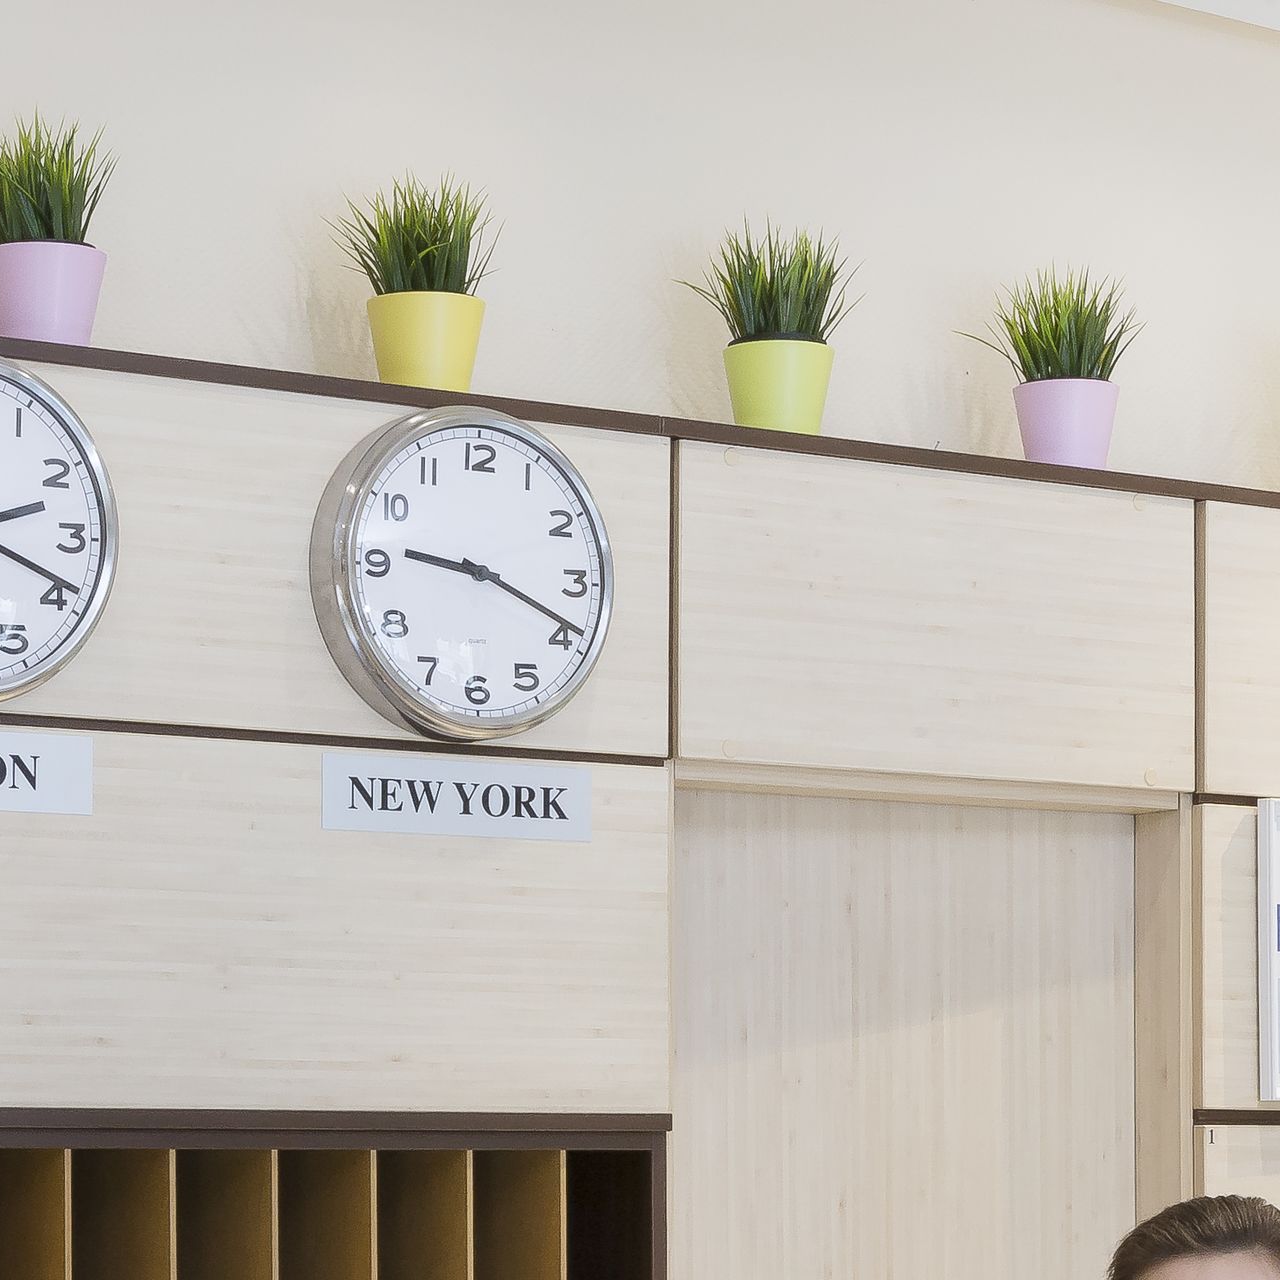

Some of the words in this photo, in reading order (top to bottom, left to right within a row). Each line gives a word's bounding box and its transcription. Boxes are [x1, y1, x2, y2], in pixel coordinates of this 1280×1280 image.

[15, 407, 22, 438] 1
[420, 457, 438, 487] 11
[464, 442, 496, 474] 12
[41, 458, 71, 489] 2
[525, 463, 531, 491] 1
[383, 493, 409, 522] 10
[56, 522, 86, 554] 3
[548, 510, 573, 539] 2
[364, 548, 391, 578] 9
[39, 580, 68, 612] 4
[561, 569, 588, 598] 3
[380, 609, 409, 639] 8
[548, 623, 573, 651] 4
[417, 656, 441, 686] 7
[513, 663, 540, 692] 5
[464, 675, 492, 706] 6
[348, 775, 444, 814] NEW
[453, 781, 569, 821] YORK
